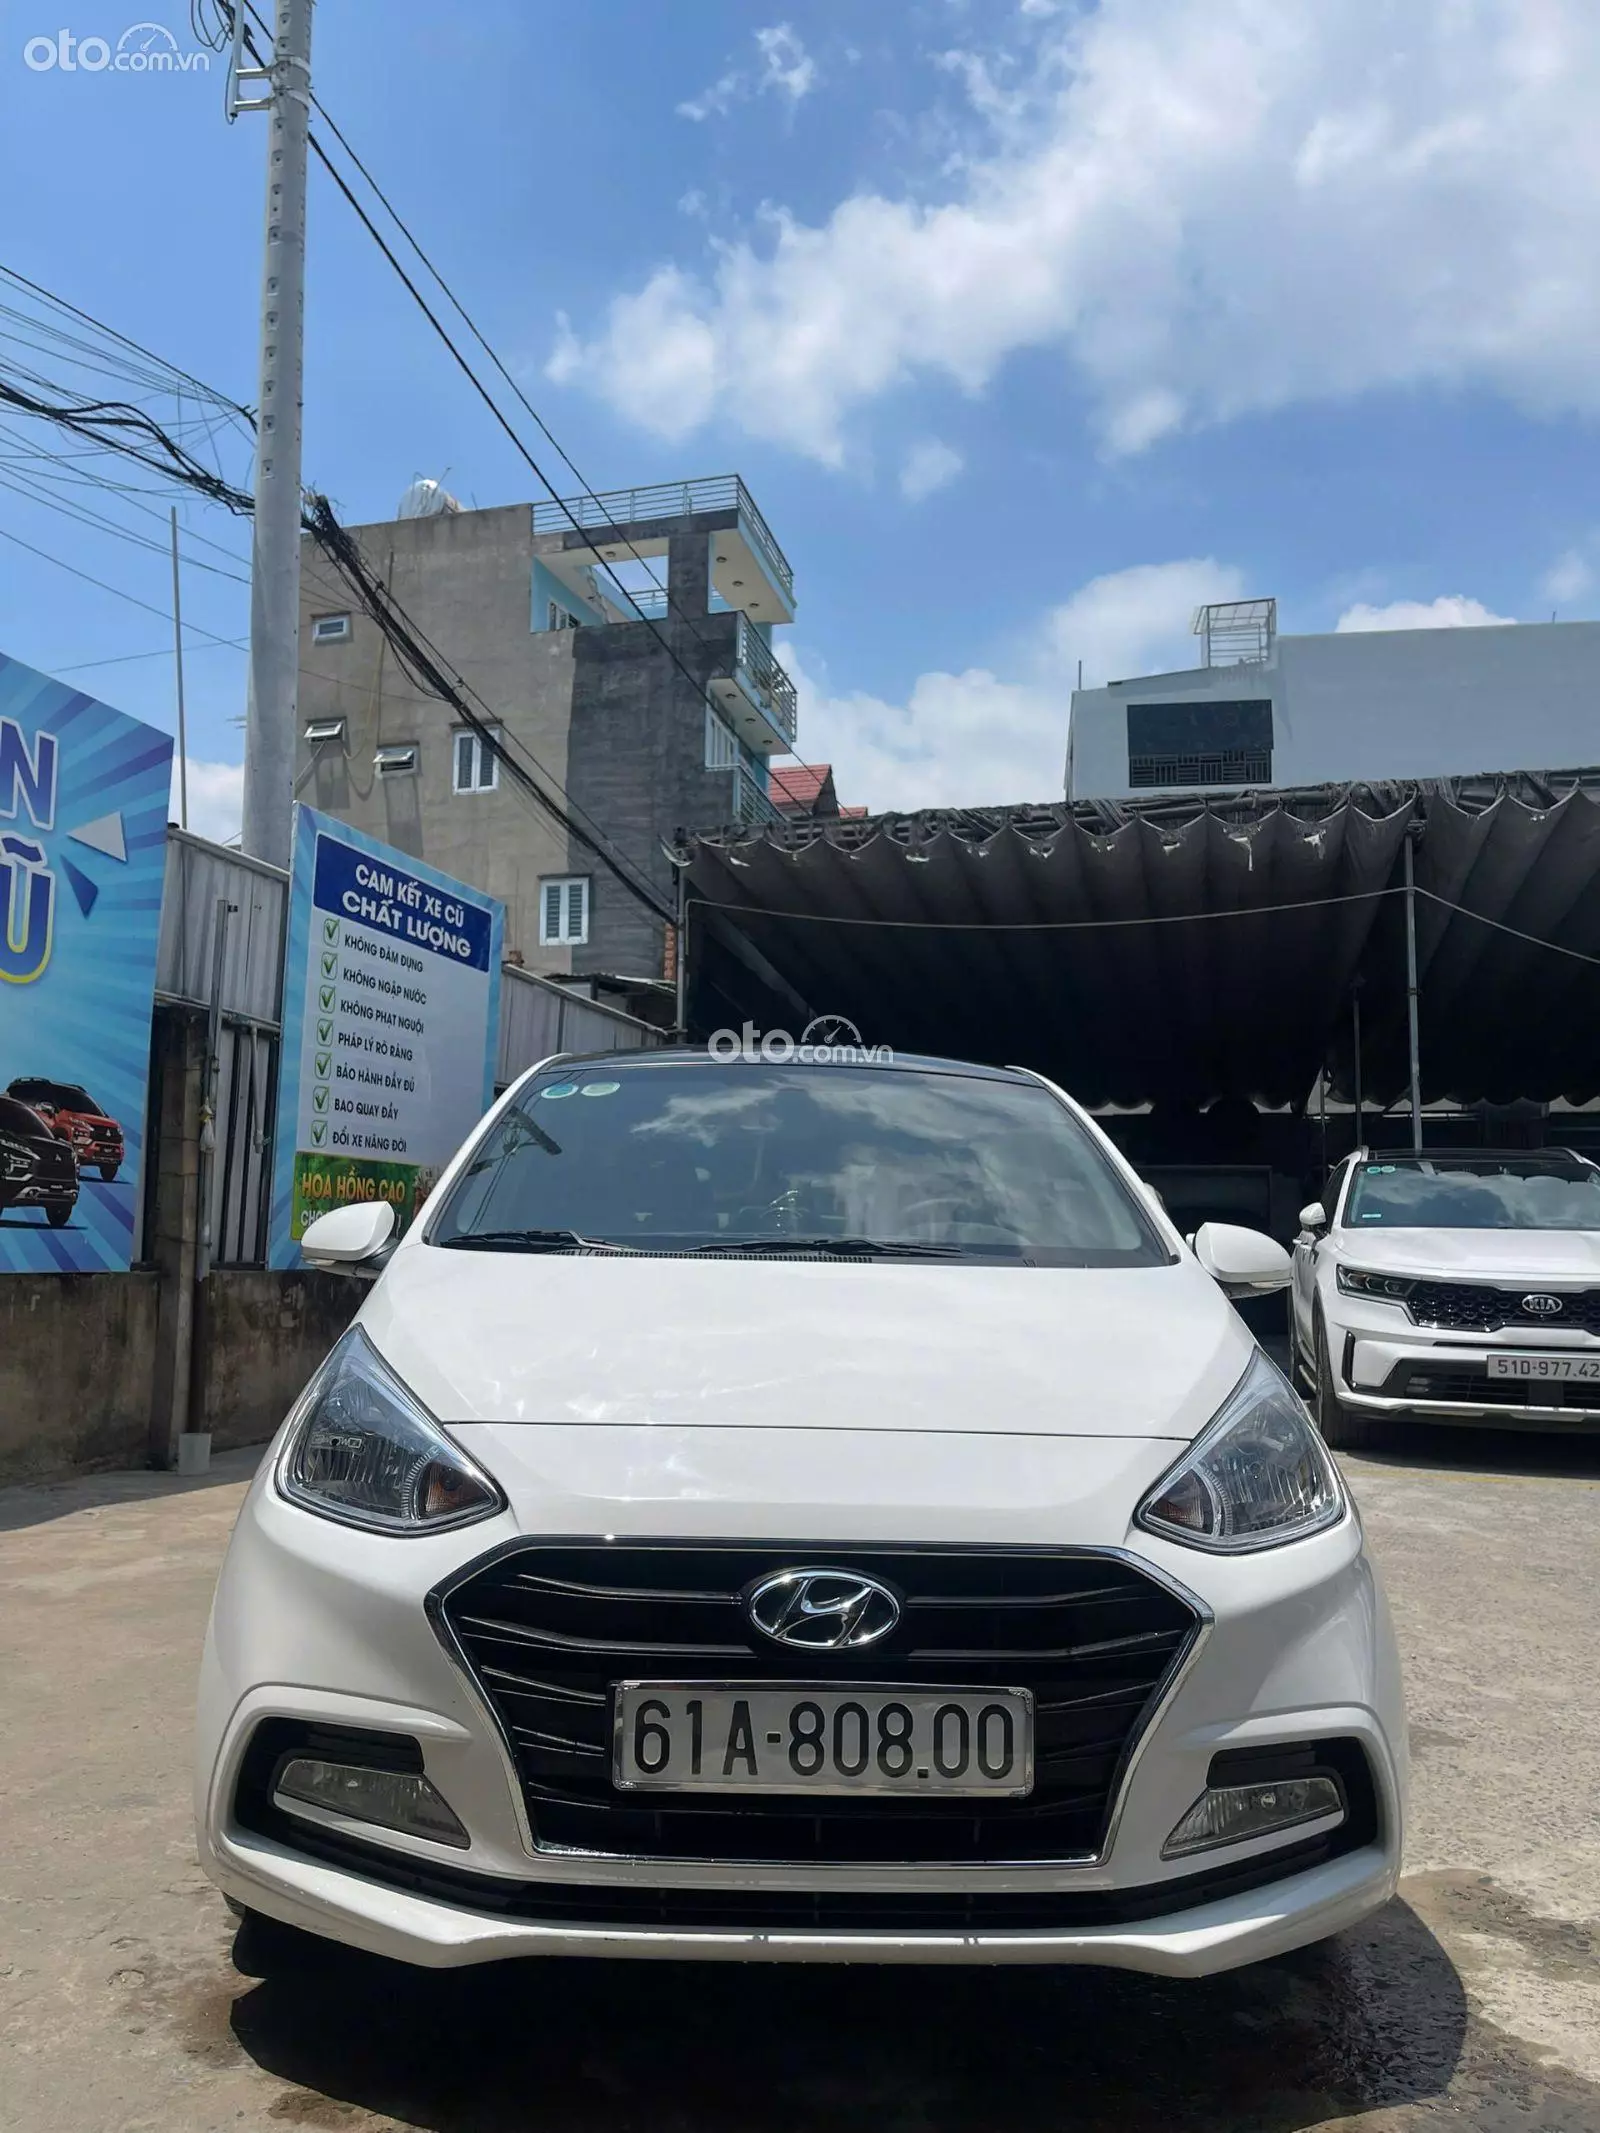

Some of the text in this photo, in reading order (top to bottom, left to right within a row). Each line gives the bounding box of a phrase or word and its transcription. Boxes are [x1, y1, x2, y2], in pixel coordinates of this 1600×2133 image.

[355, 864, 464, 928] CAM KẾT XE CŨ
[342, 890, 471, 958] CHẤT LƯỢNG
[345, 934, 377, 956] KHÔNG
[343, 968, 376, 989] KHÔNG
[340, 1000, 373, 1019] KHÔNG
[338, 1032, 362, 1048] PHÁP
[336, 1062, 355, 1080] BẢO
[358, 1068, 383, 1087] HÀNH
[334, 1098, 354, 1113] BAO
[356, 1102, 380, 1117] QUAY
[352, 1134, 363, 1148] XE
[302, 1165, 405, 1202] HOA HỒNG CAO
[1528, 1298, 1557, 1310] KIA
[634, 1699, 1013, 1780] 61A-808.00
